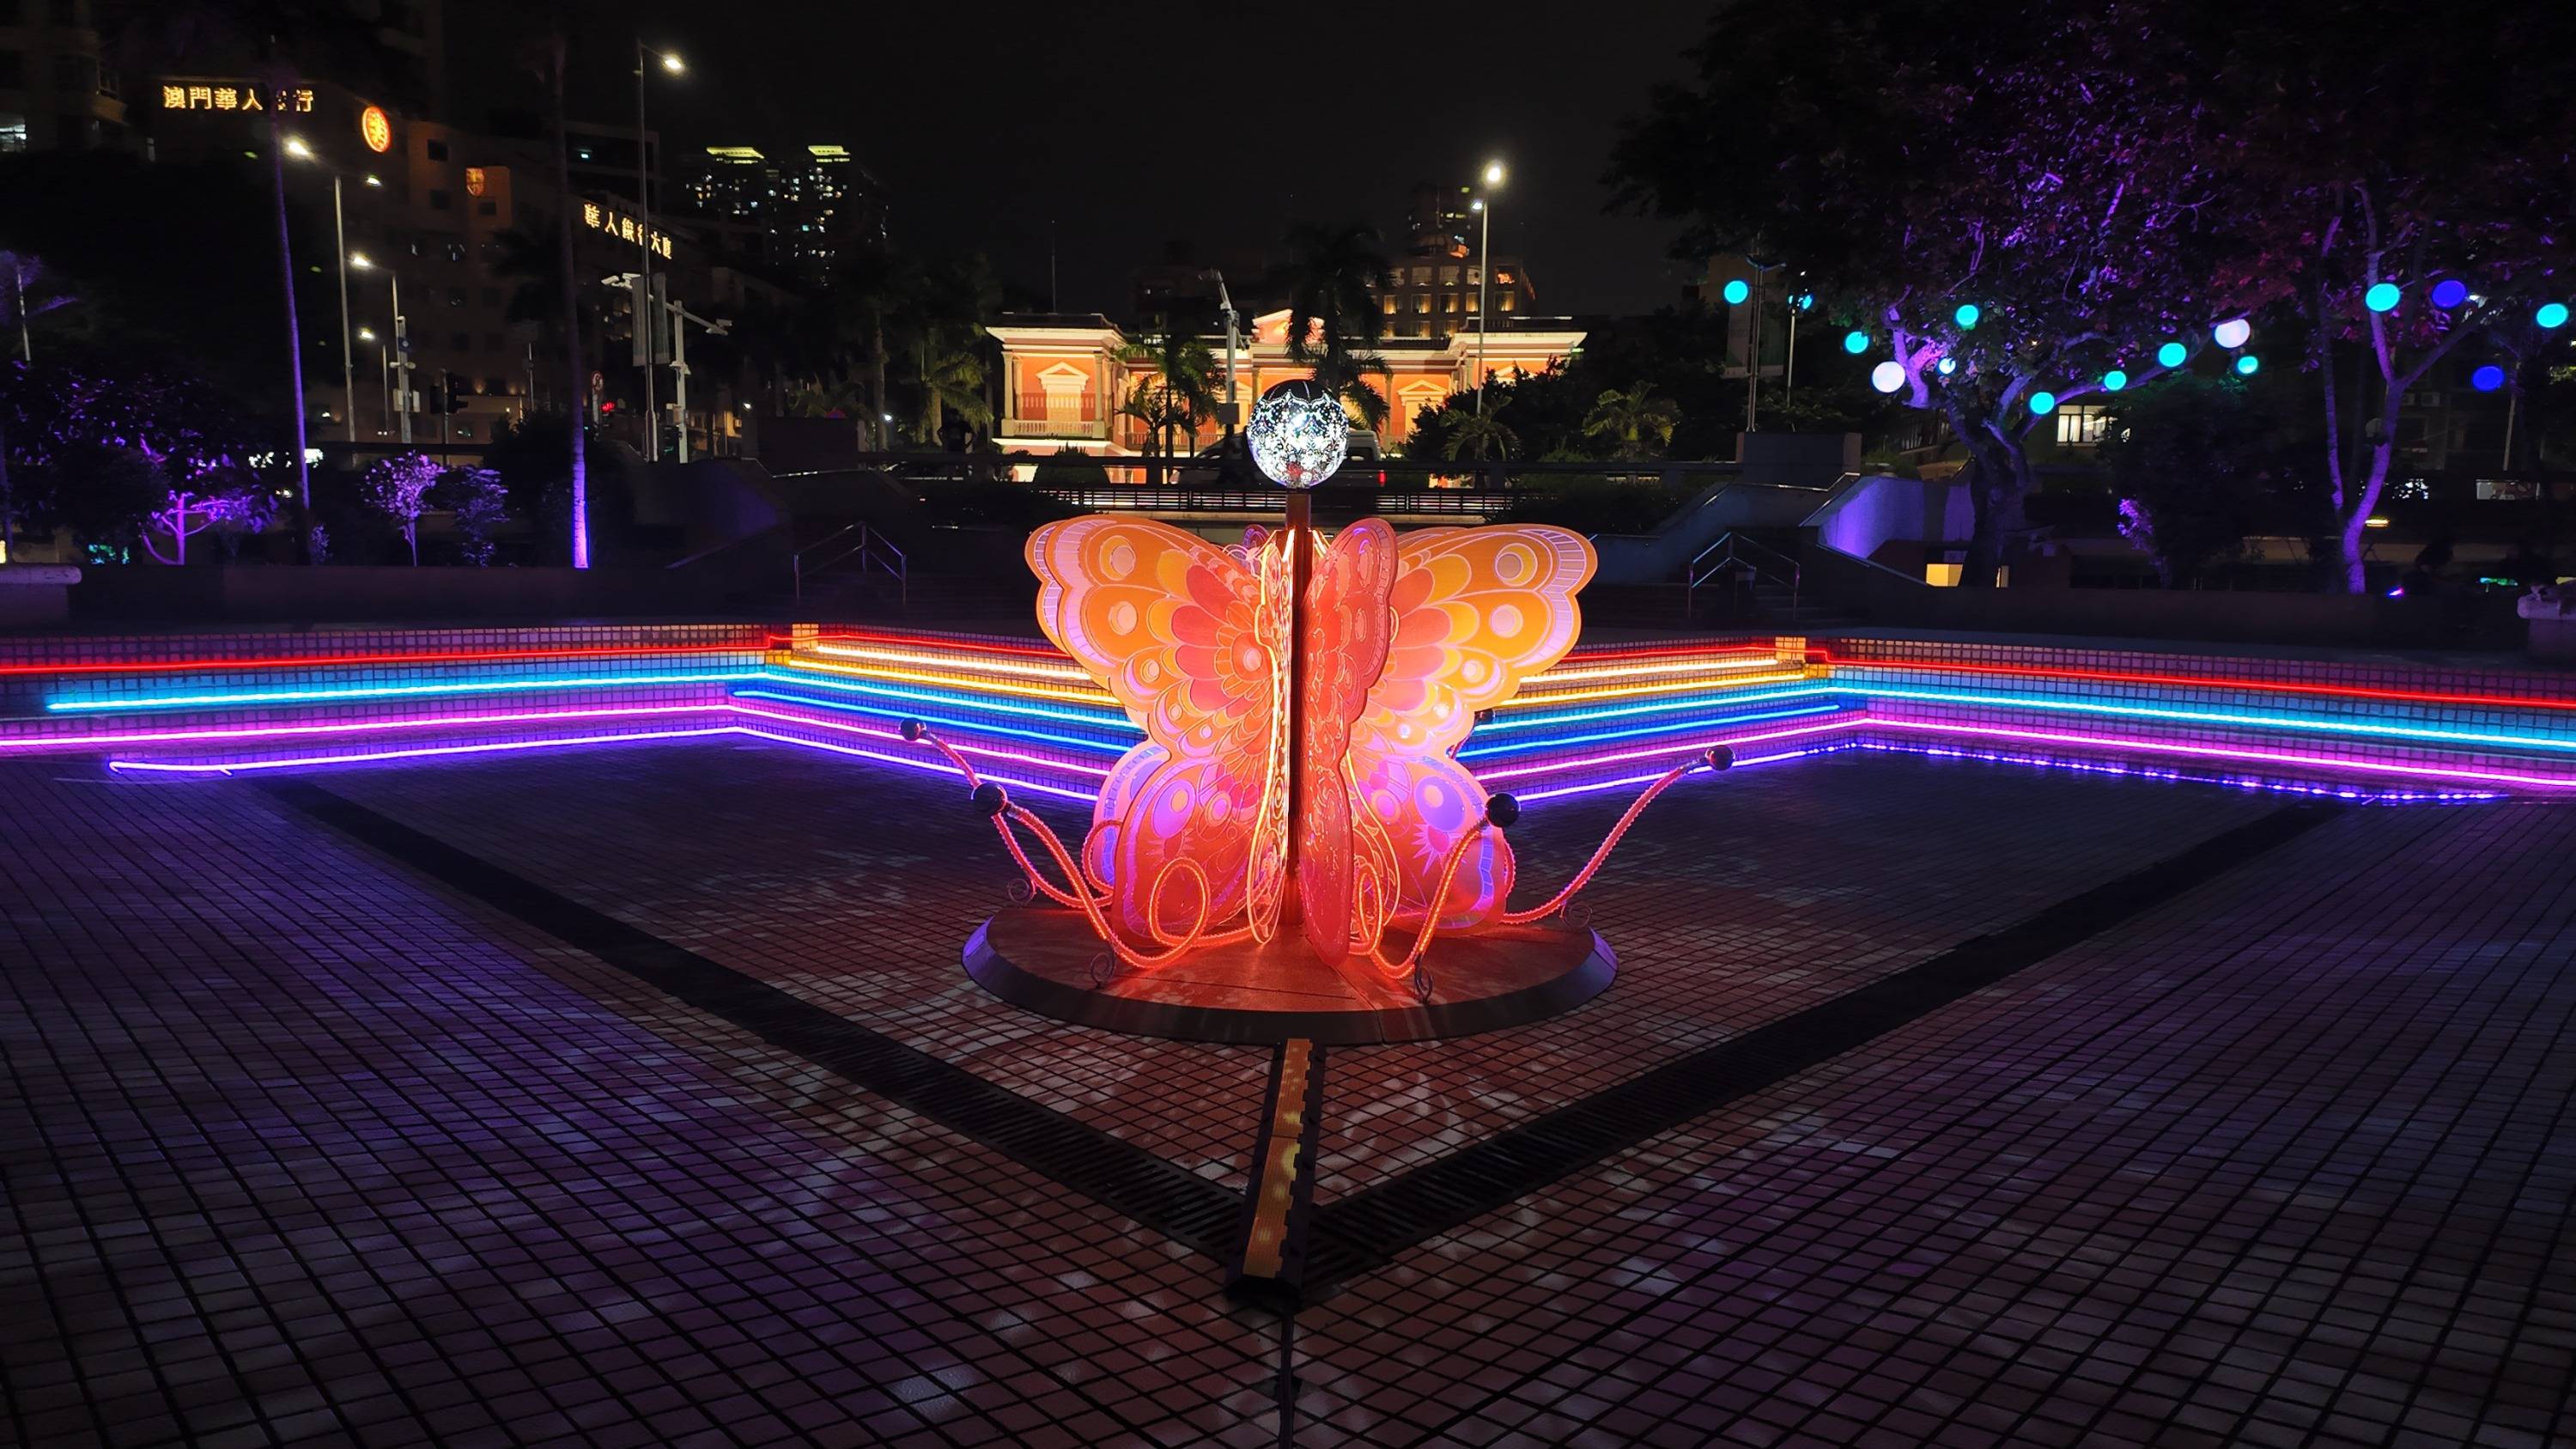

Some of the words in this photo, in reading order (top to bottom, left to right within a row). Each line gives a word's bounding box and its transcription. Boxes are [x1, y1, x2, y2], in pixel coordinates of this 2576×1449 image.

[163, 85, 314, 113] 澳門華人行
